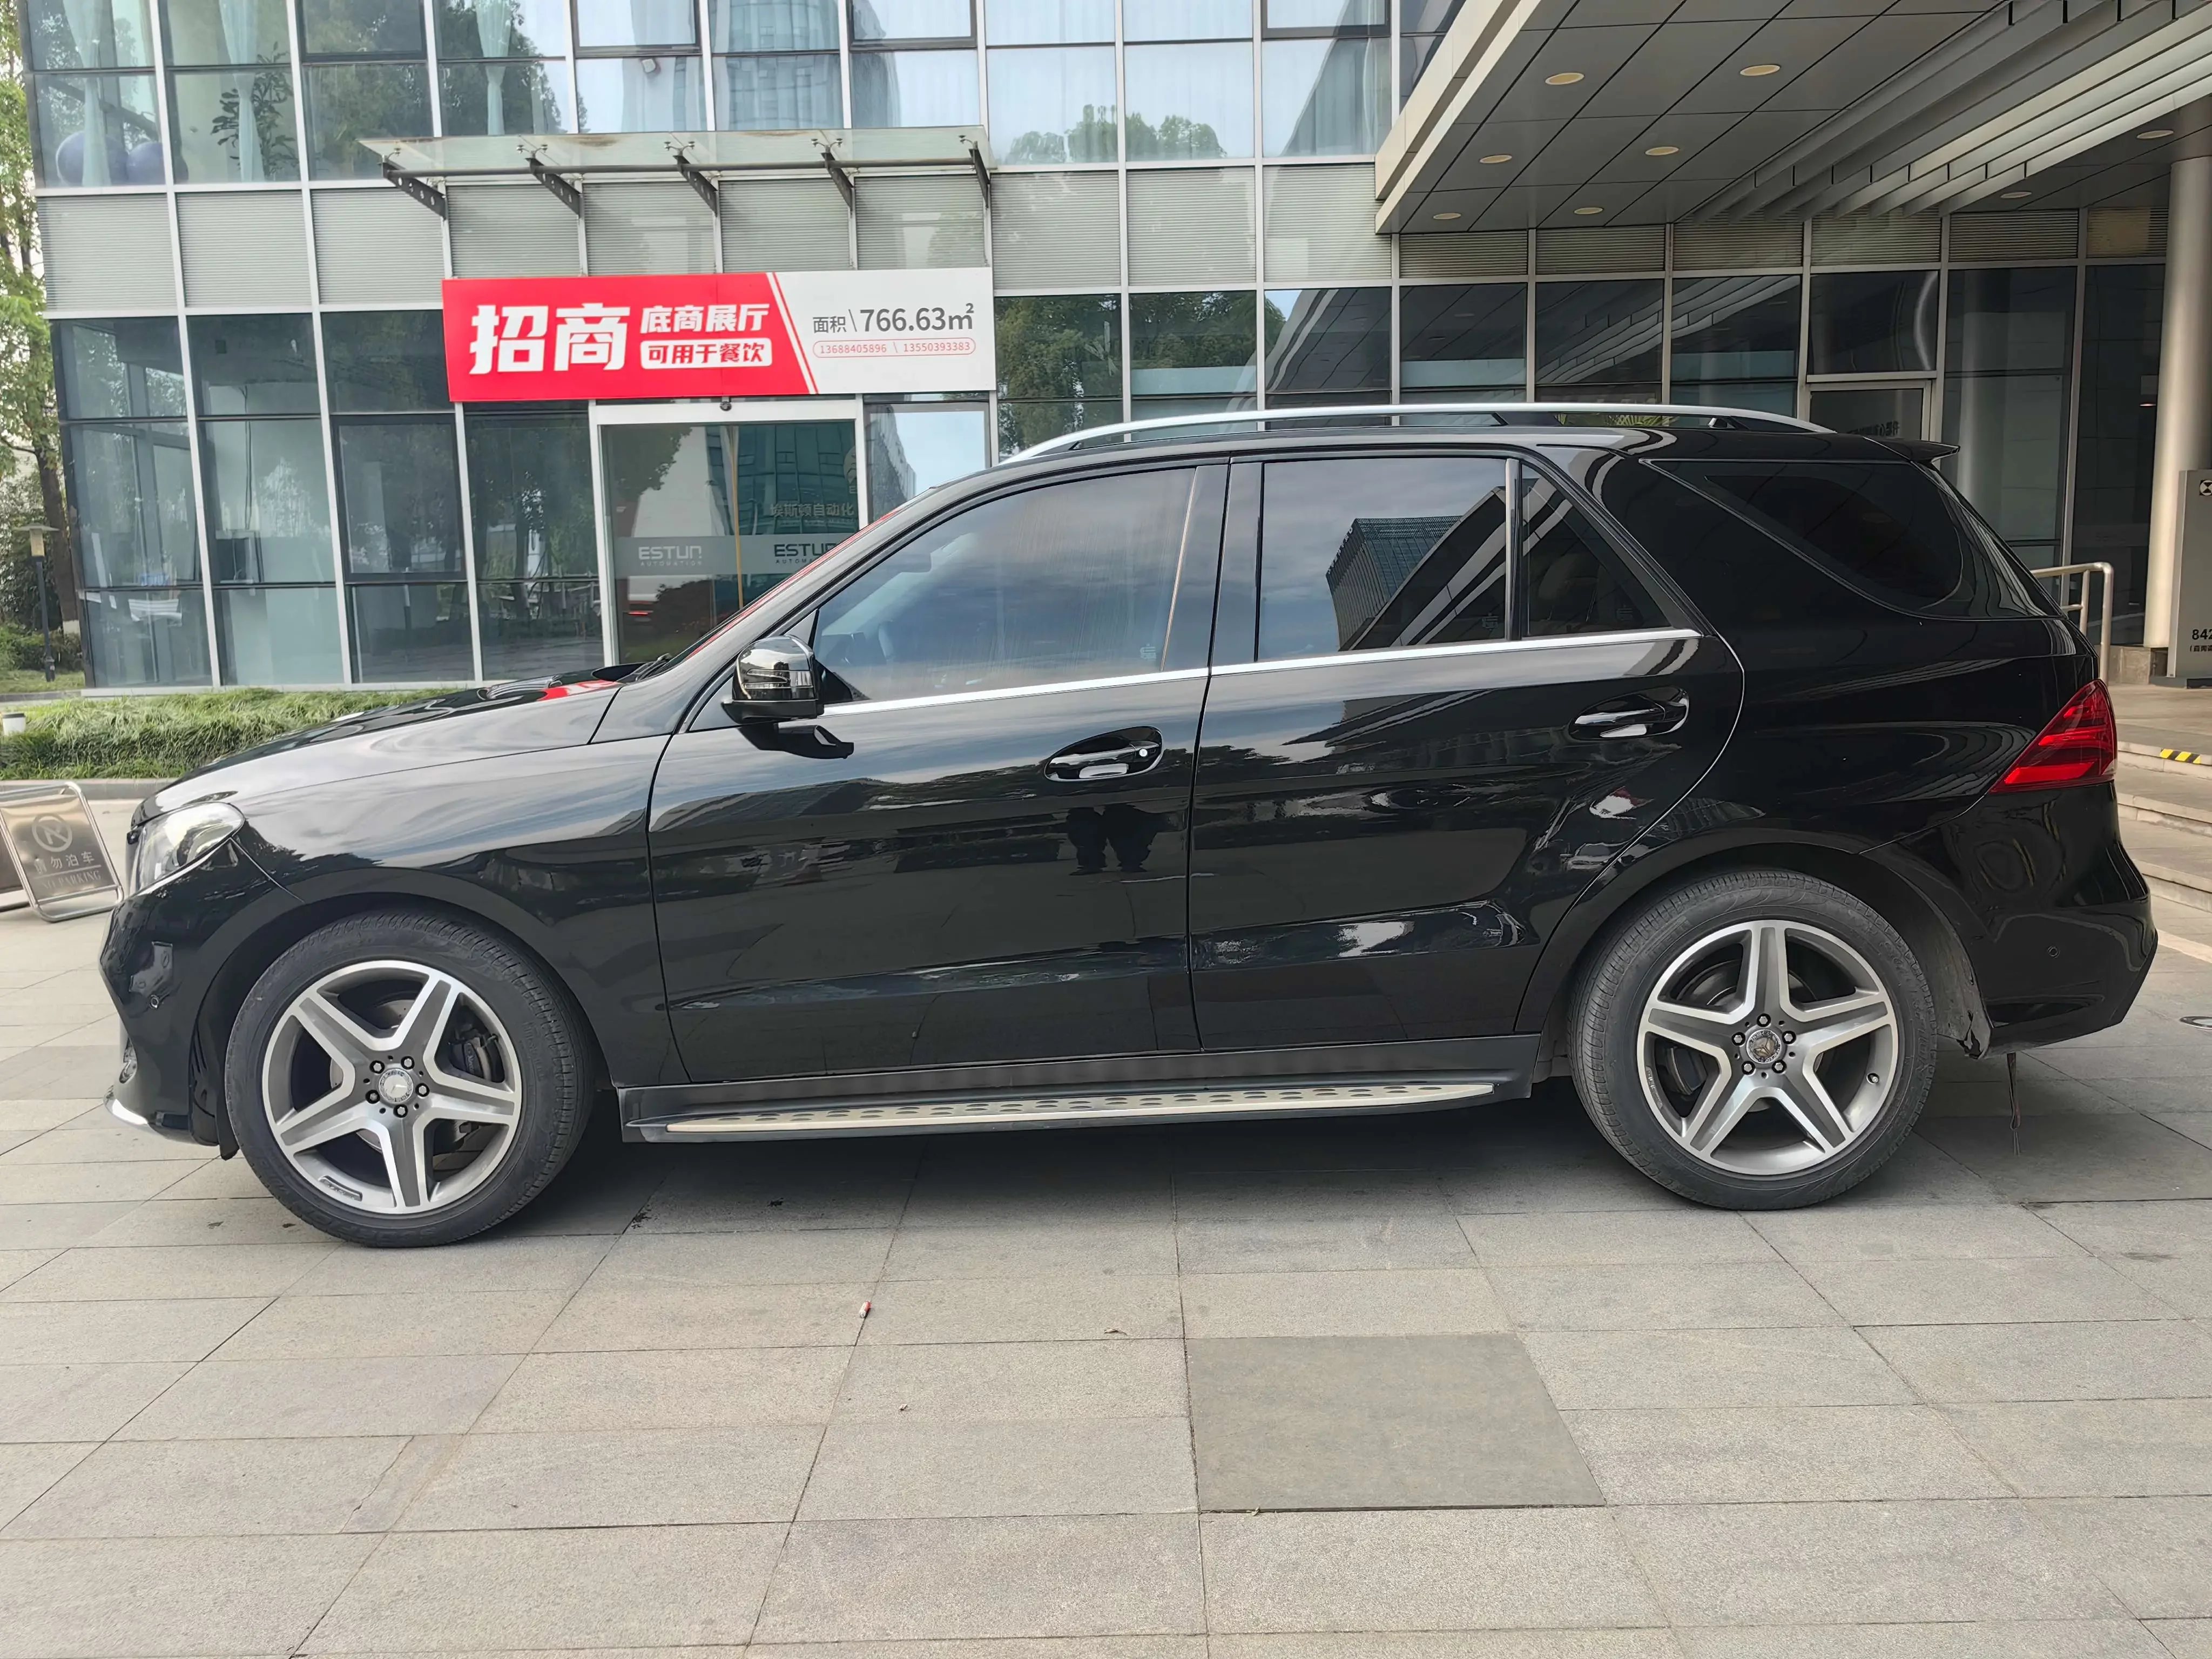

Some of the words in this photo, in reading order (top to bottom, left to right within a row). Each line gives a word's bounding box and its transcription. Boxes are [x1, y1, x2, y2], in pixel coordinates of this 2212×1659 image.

[640, 304, 770, 334] 底商展厅
[813, 315, 847, 333] 面积
[469, 302, 631, 374] 招商
[820, 344, 887, 354] 13688405896
[903, 341, 970, 352] 13550393383
[648, 342, 765, 364] 可用于餐饮
[57, 870, 102, 887] PARKING
